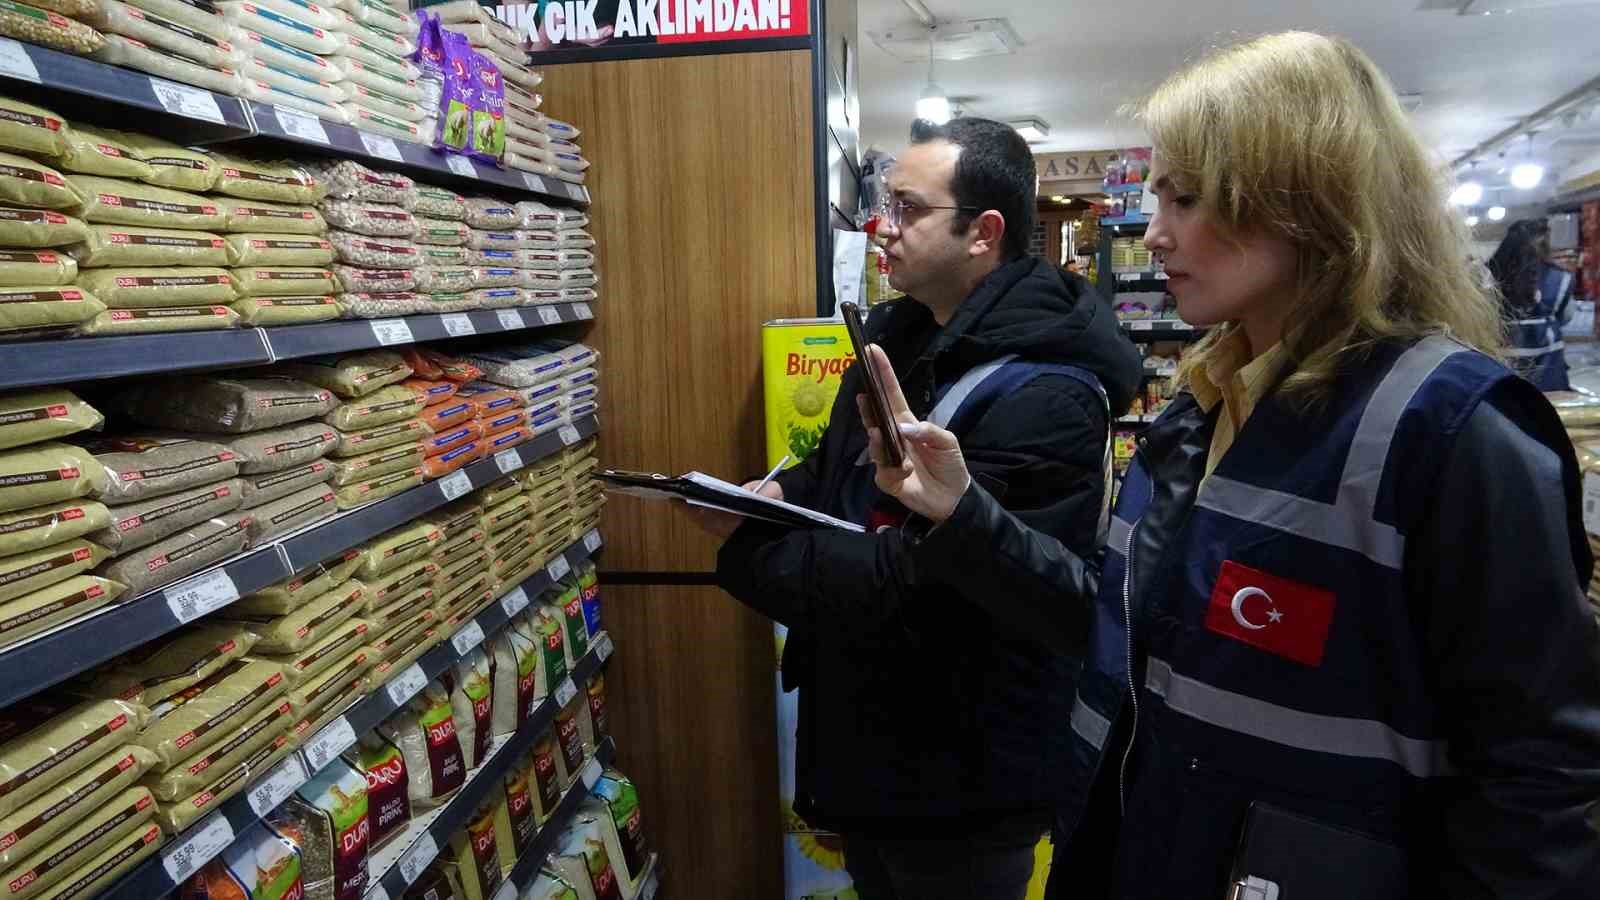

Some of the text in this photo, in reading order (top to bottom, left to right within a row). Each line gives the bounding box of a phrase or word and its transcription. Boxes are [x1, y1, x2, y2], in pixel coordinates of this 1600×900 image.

[545, 0, 599, 44] ÇIK
[613, 0, 791, 38] AKLIMDAN!
[367, 759, 402, 790] DURU
[10, 873, 34, 892] DURU
